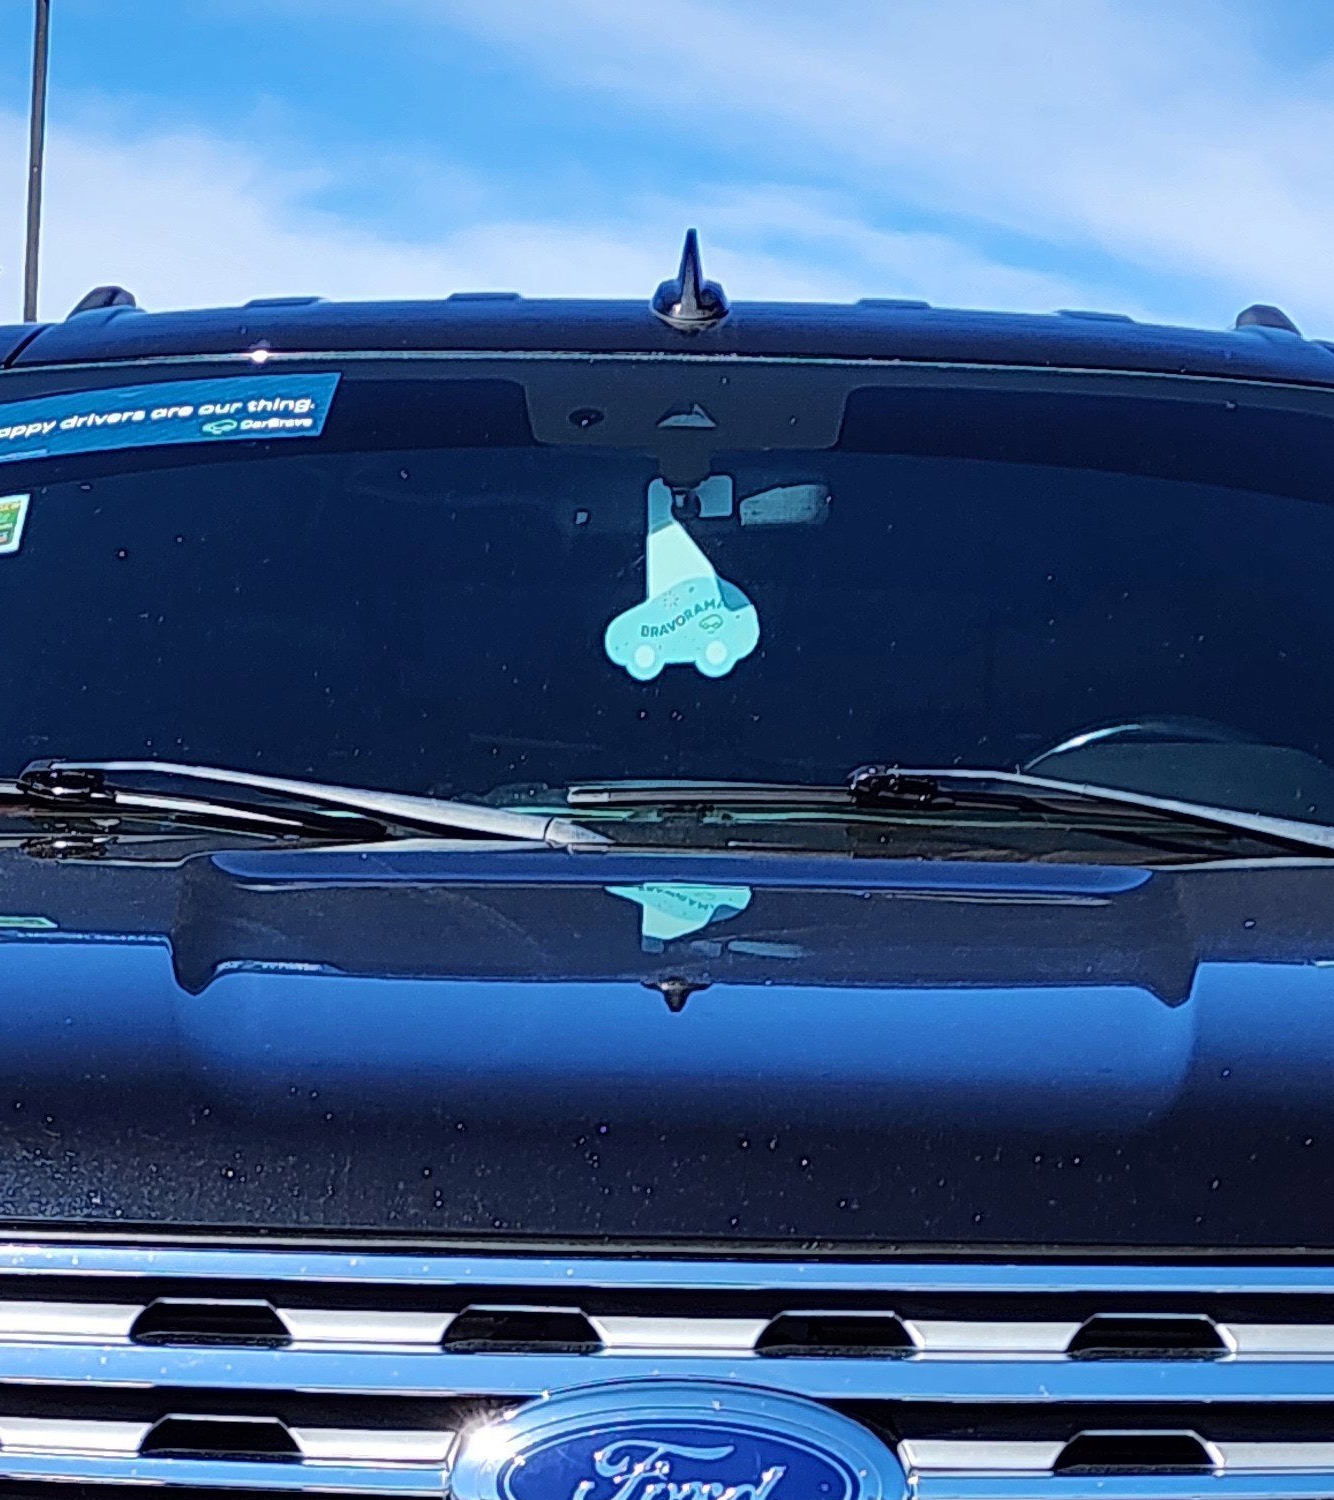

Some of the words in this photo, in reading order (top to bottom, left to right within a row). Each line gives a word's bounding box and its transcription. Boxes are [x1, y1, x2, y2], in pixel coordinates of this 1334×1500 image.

[59, 410, 146, 430] drivers
[150, 404, 194, 420] are
[198, 401, 243, 416] our
[246, 396, 316, 414] thing.
